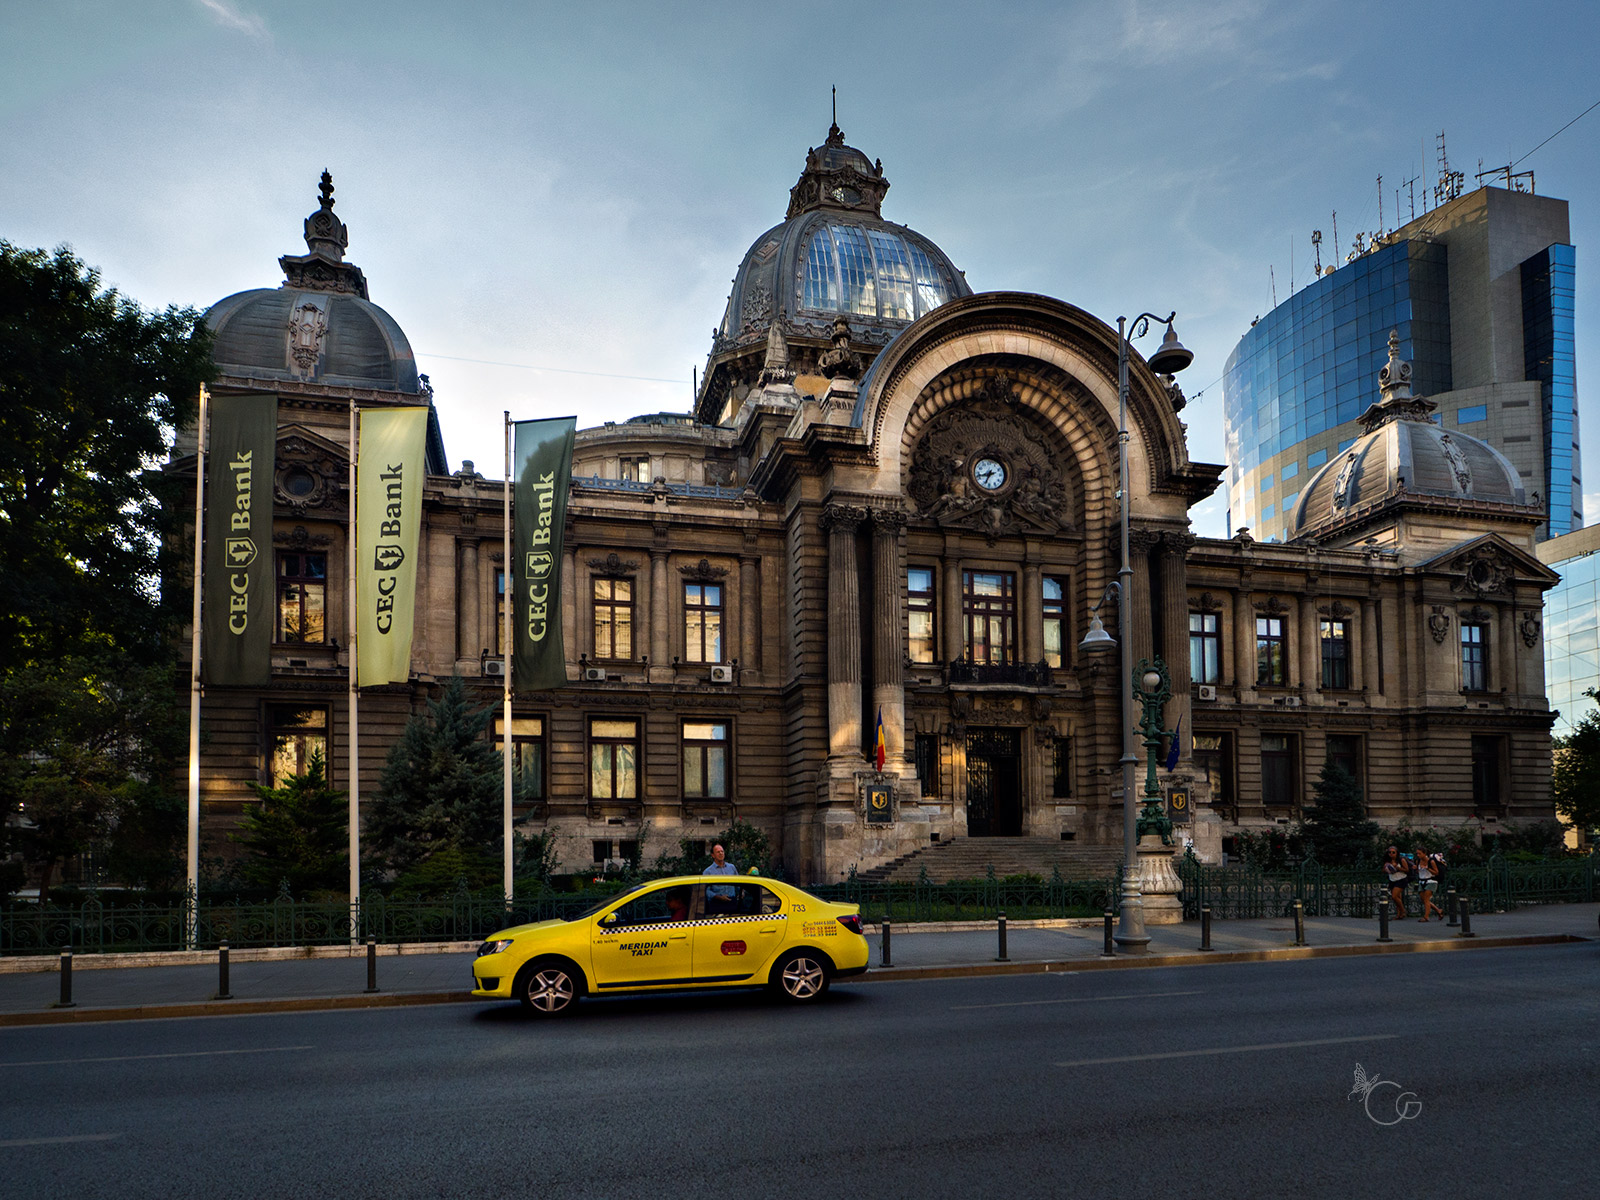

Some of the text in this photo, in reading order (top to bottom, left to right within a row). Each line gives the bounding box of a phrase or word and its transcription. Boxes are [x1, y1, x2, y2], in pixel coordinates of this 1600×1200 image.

[229, 450, 252, 635] CEC Bank
[377, 463, 402, 634] CEC Bank
[528, 471, 554, 642] CEC Bank
[619, 941, 668, 951] MERIDIAN
[631, 949, 654, 957] TAXI
[792, 904, 806, 912] 733
